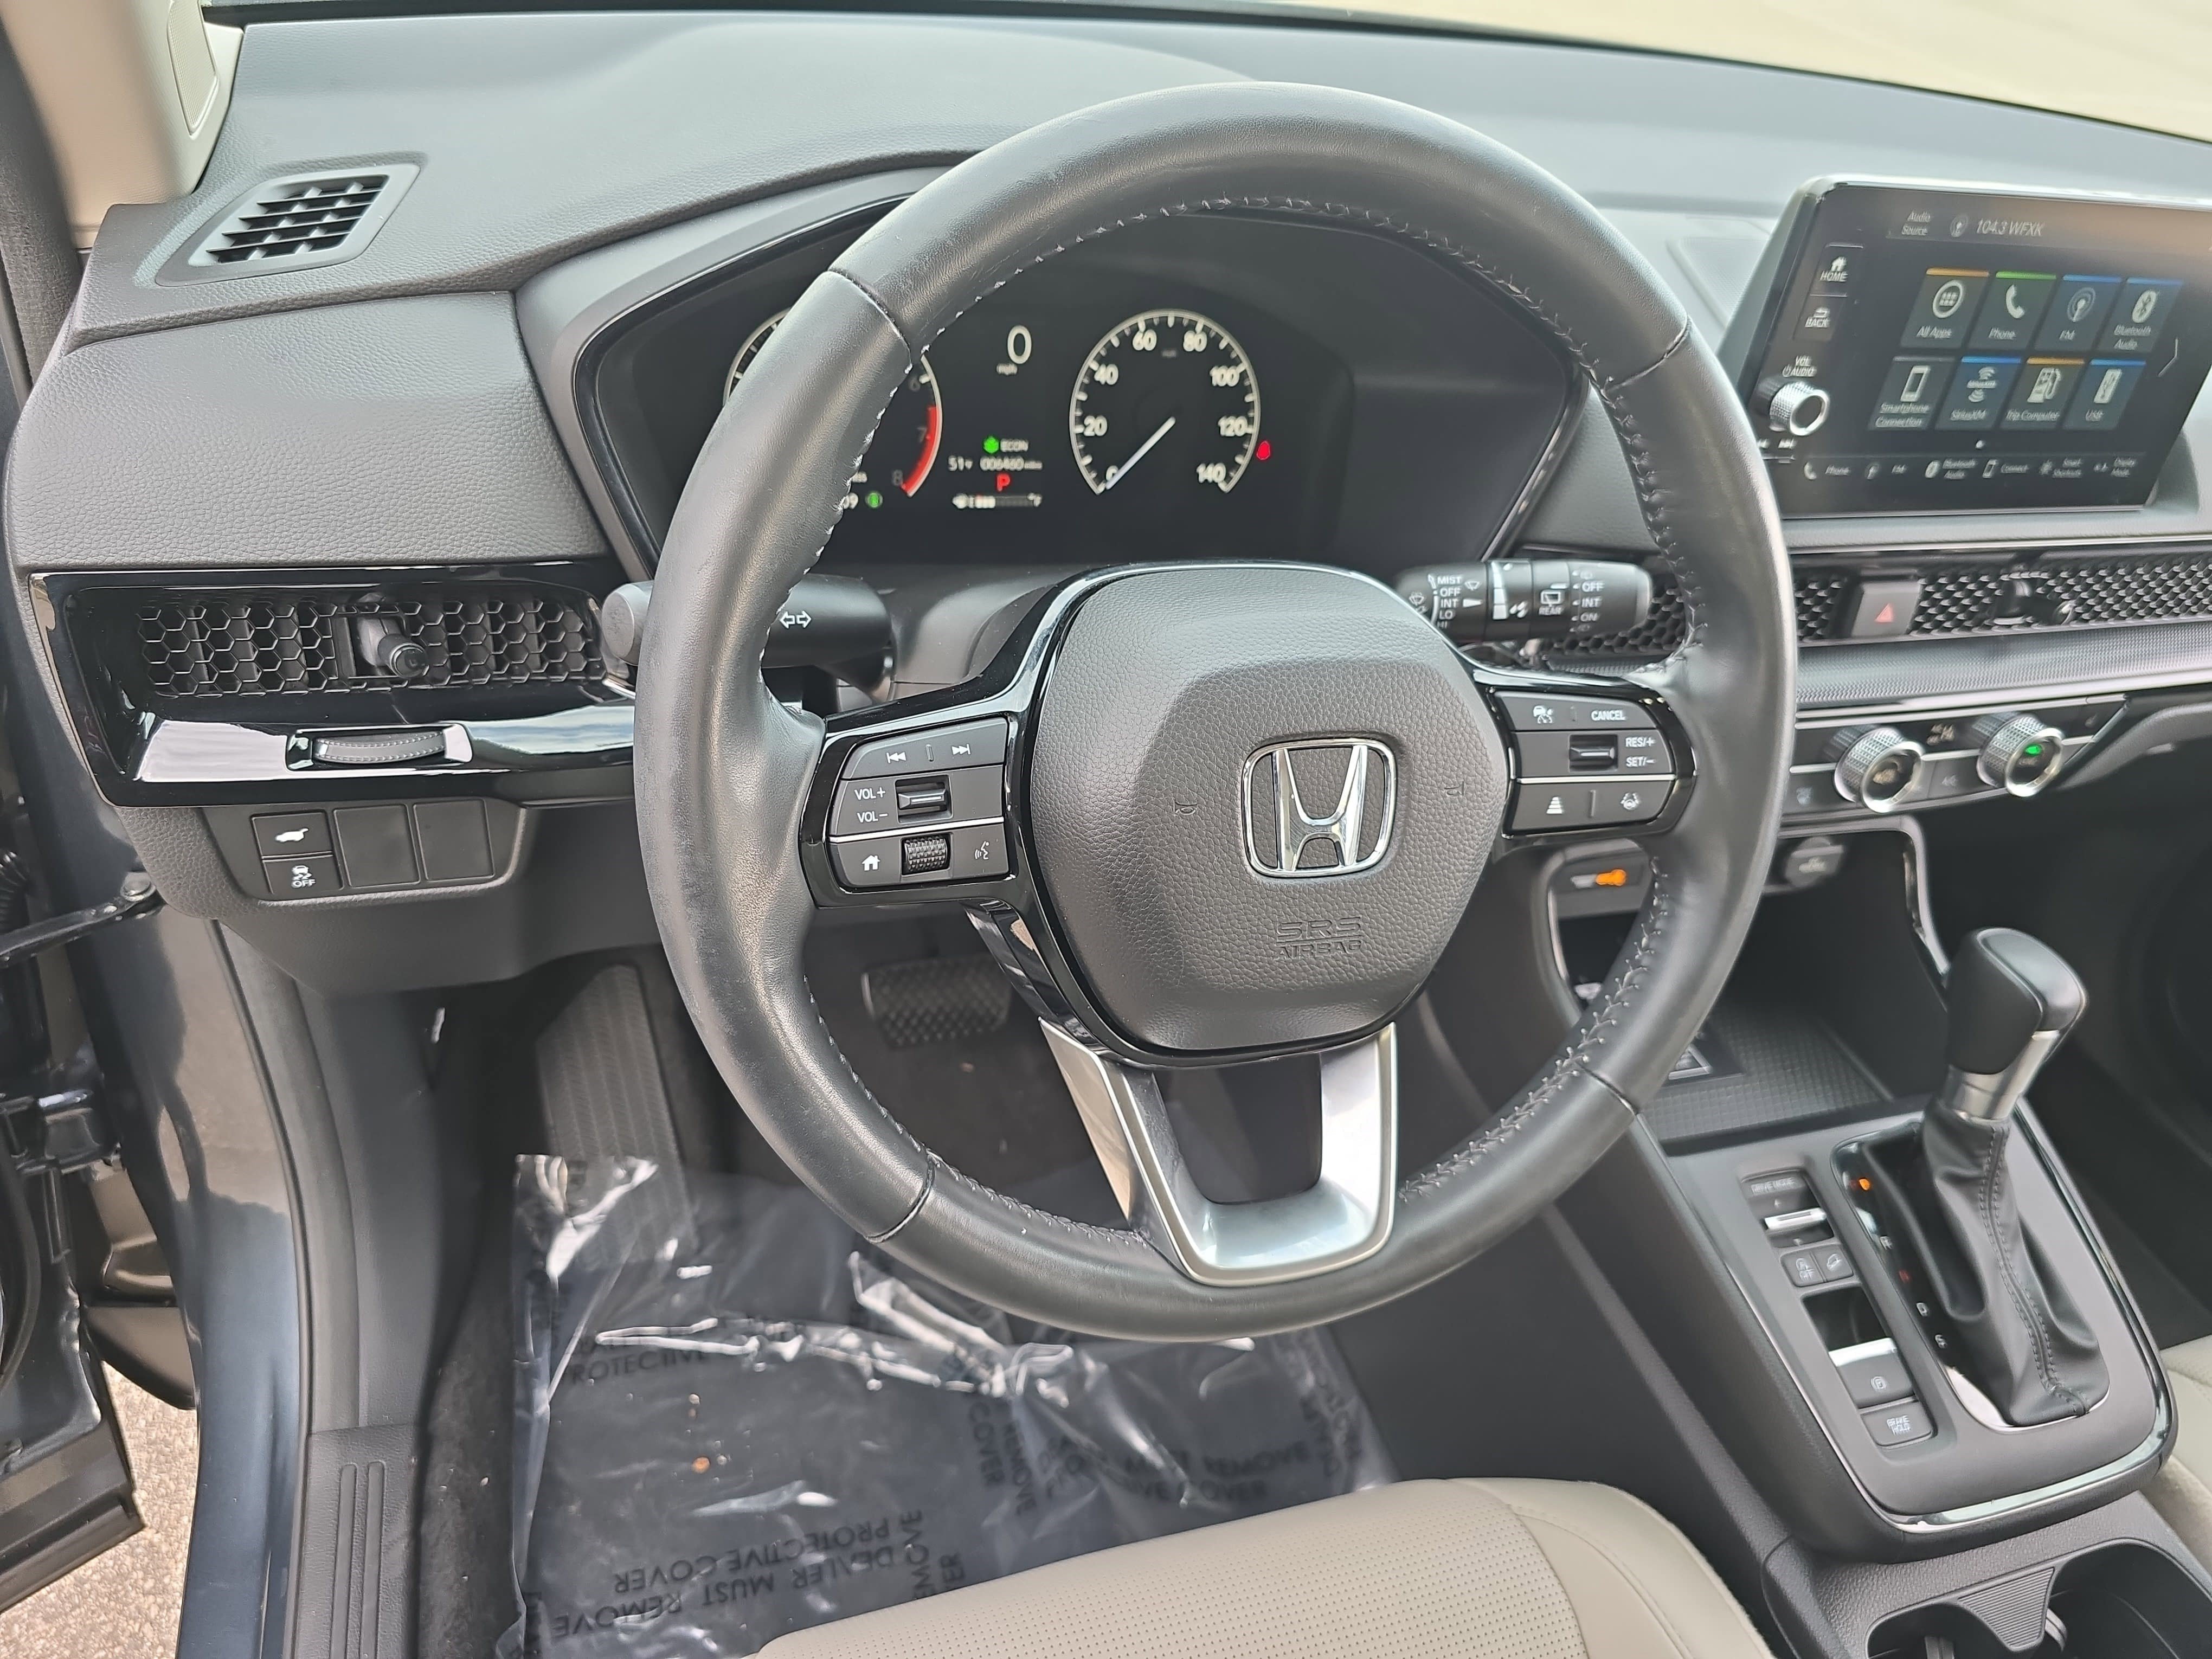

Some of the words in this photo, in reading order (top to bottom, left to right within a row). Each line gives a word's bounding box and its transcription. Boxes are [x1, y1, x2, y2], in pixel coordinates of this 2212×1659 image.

[1907, 211, 1931, 222] Audio
[1901, 223, 1928, 235] Source
[2009, 220, 2044, 236] WFXK
[1820, 271, 1848, 281] HOME
[1805, 317, 1829, 327] BACK
[1916, 326, 1928, 338] All
[1930, 326, 1952, 338] Apps
[1988, 327, 2016, 340] Phone
[2114, 325, 2151, 336] Bluetooth
[1007, 325, 1032, 364] 0
[1133, 329, 1157, 351] 60
[1183, 330, 1207, 352] 80
[2114, 338, 2138, 350] Audio
[1795, 355, 1811, 366] VOL
[1094, 364, 1118, 385] 40
[1210, 365, 1240, 387] 100
[1791, 366, 1816, 377] AUDIO
[909, 378, 921, 391] 6
[1880, 403, 1930, 414] Smartphone
[1950, 409, 1987, 421] SiriusXM
[2021, 410, 2060, 421] Computer
[1084, 415, 1108, 436] 20
[1218, 415, 1248, 436] 120
[1875, 416, 1924, 427] Connection
[892, 470, 904, 487] 8
[1197, 463, 1226, 483] 140
[996, 473, 1011, 491] P
[1437, 576, 1462, 585] MIST
[1582, 581, 1604, 592] OFF
[1440, 587, 1462, 597] OFF
[1441, 598, 1459, 608] INT
[1581, 597, 1602, 608] INT
[1439, 609, 1455, 620] LO
[1539, 606, 1564, 615] REAR
[1580, 612, 1599, 622] ON
[1591, 710, 1626, 721] CANCEL
[1626, 737, 1656, 748] RES/+
[291, 878, 316, 888] OFF
[1276, 916, 1362, 942] SRS
[1274, 938, 1362, 960] AIRBAG
[1916, 1302, 1928, 1317] D
[724, 1517, 890, 1572] PROTECTIVE
[791, 1545, 894, 1590] DEALER
[614, 1555, 718, 1594] COVER
[702, 1571, 774, 1606] MUST
[550, 1591, 682, 1638] REMOVE
